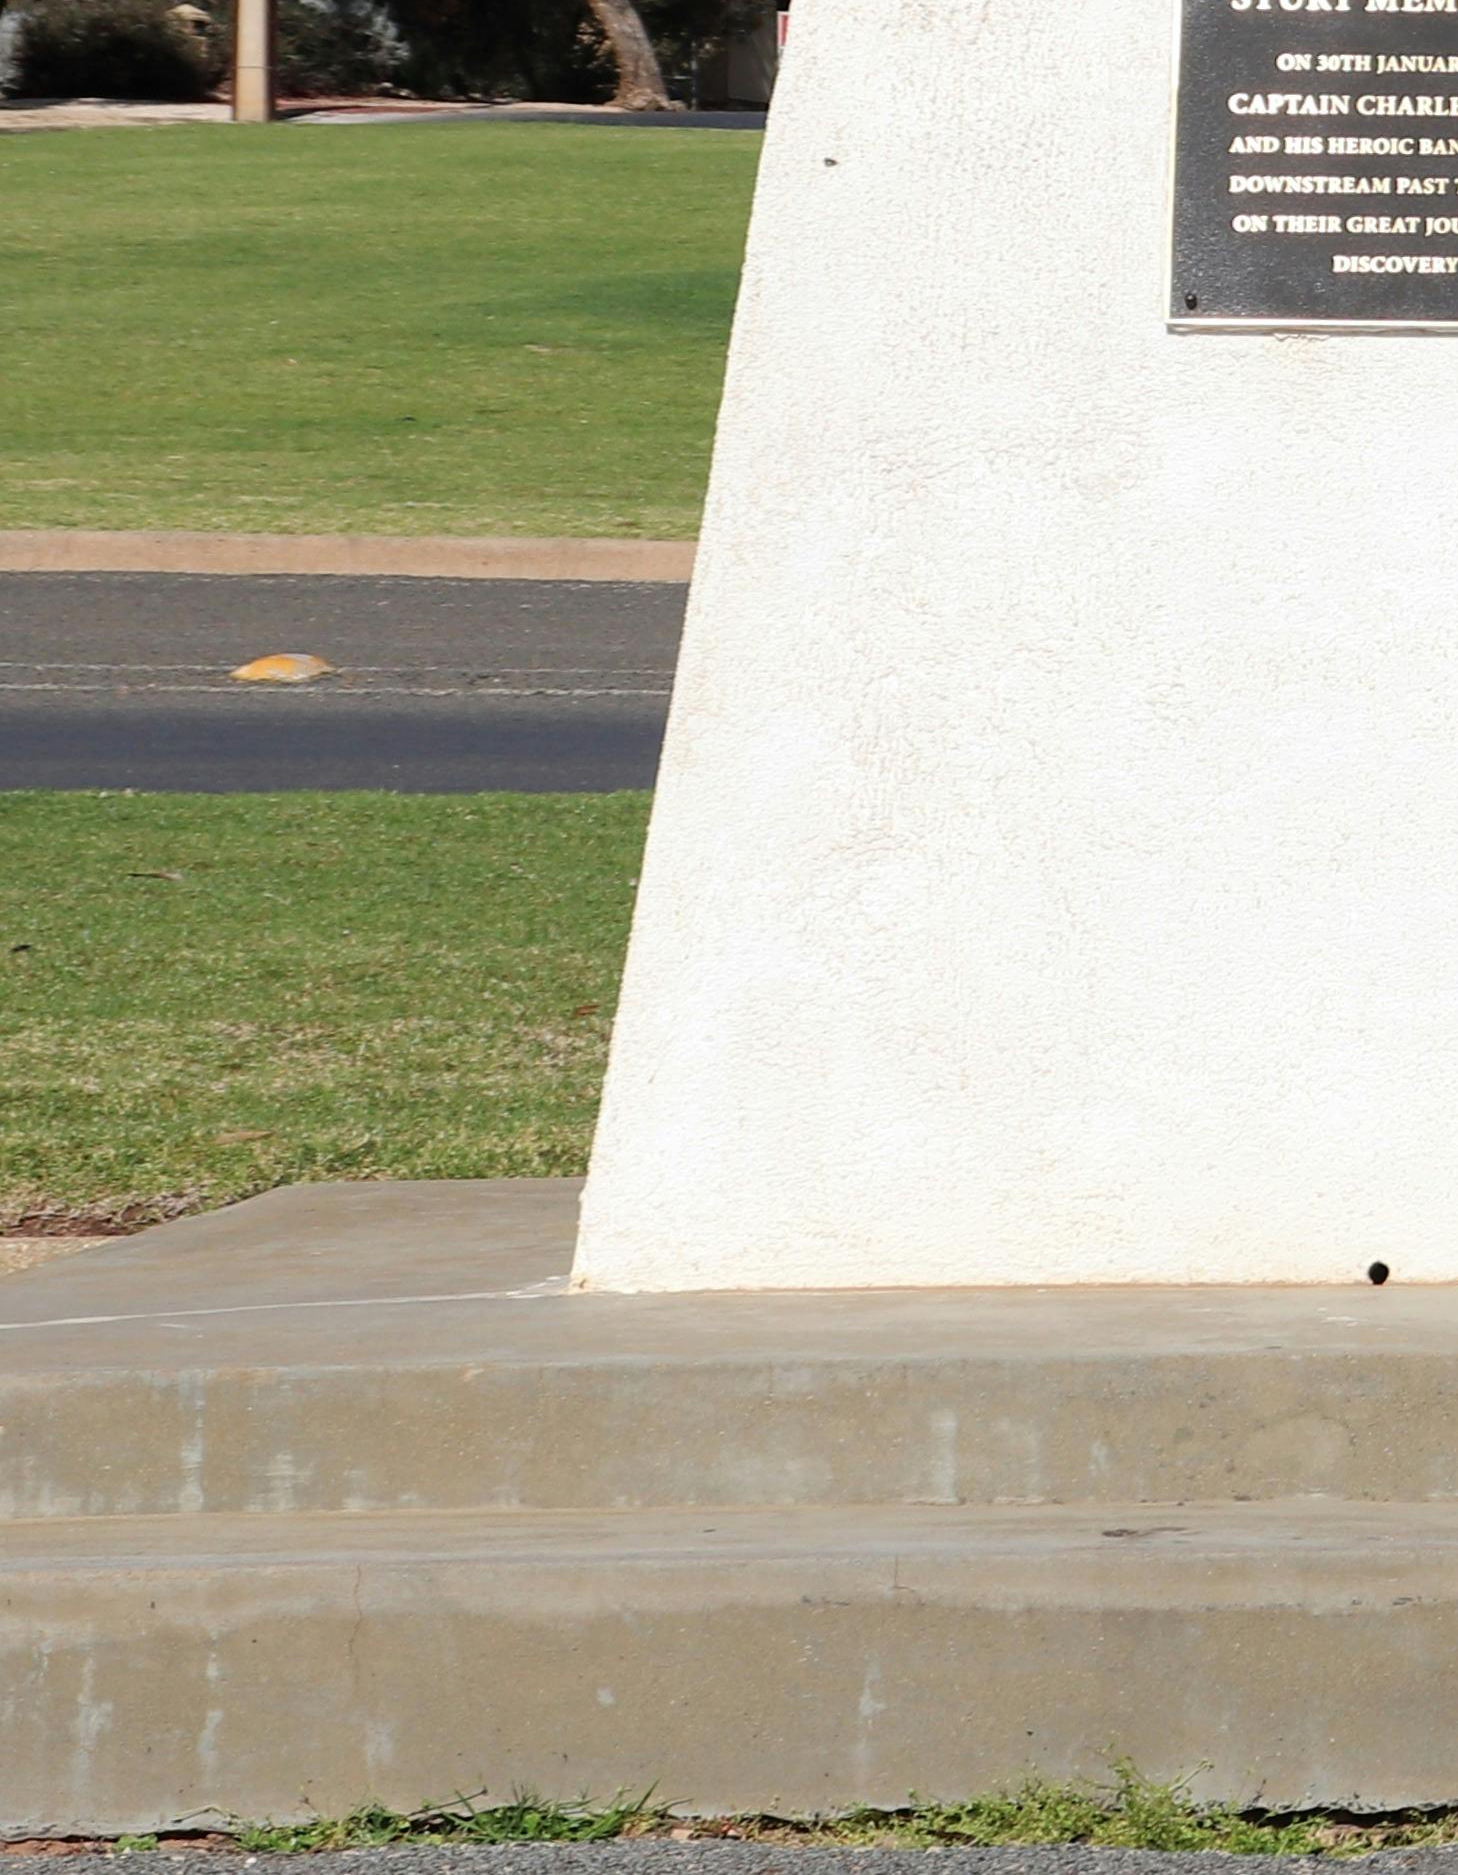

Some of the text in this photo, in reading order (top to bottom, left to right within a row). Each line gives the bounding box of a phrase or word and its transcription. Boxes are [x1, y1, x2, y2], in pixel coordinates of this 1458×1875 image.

[1275, 52, 1313, 72] ON
[1315, 53, 1373, 73] 30TH
[1227, 92, 1352, 117] CAPTAIN
[1228, 135, 1282, 155] AND
[1283, 135, 1325, 156] HIS
[1326, 136, 1415, 156] HEROIC
[1228, 174, 1392, 195] DOWNSTREAM
[1396, 176, 1451, 195] PAST
[1231, 213, 1270, 234] ON
[1271, 214, 1343, 234] THEIR
[1345, 215, 1422, 234] GREAT
